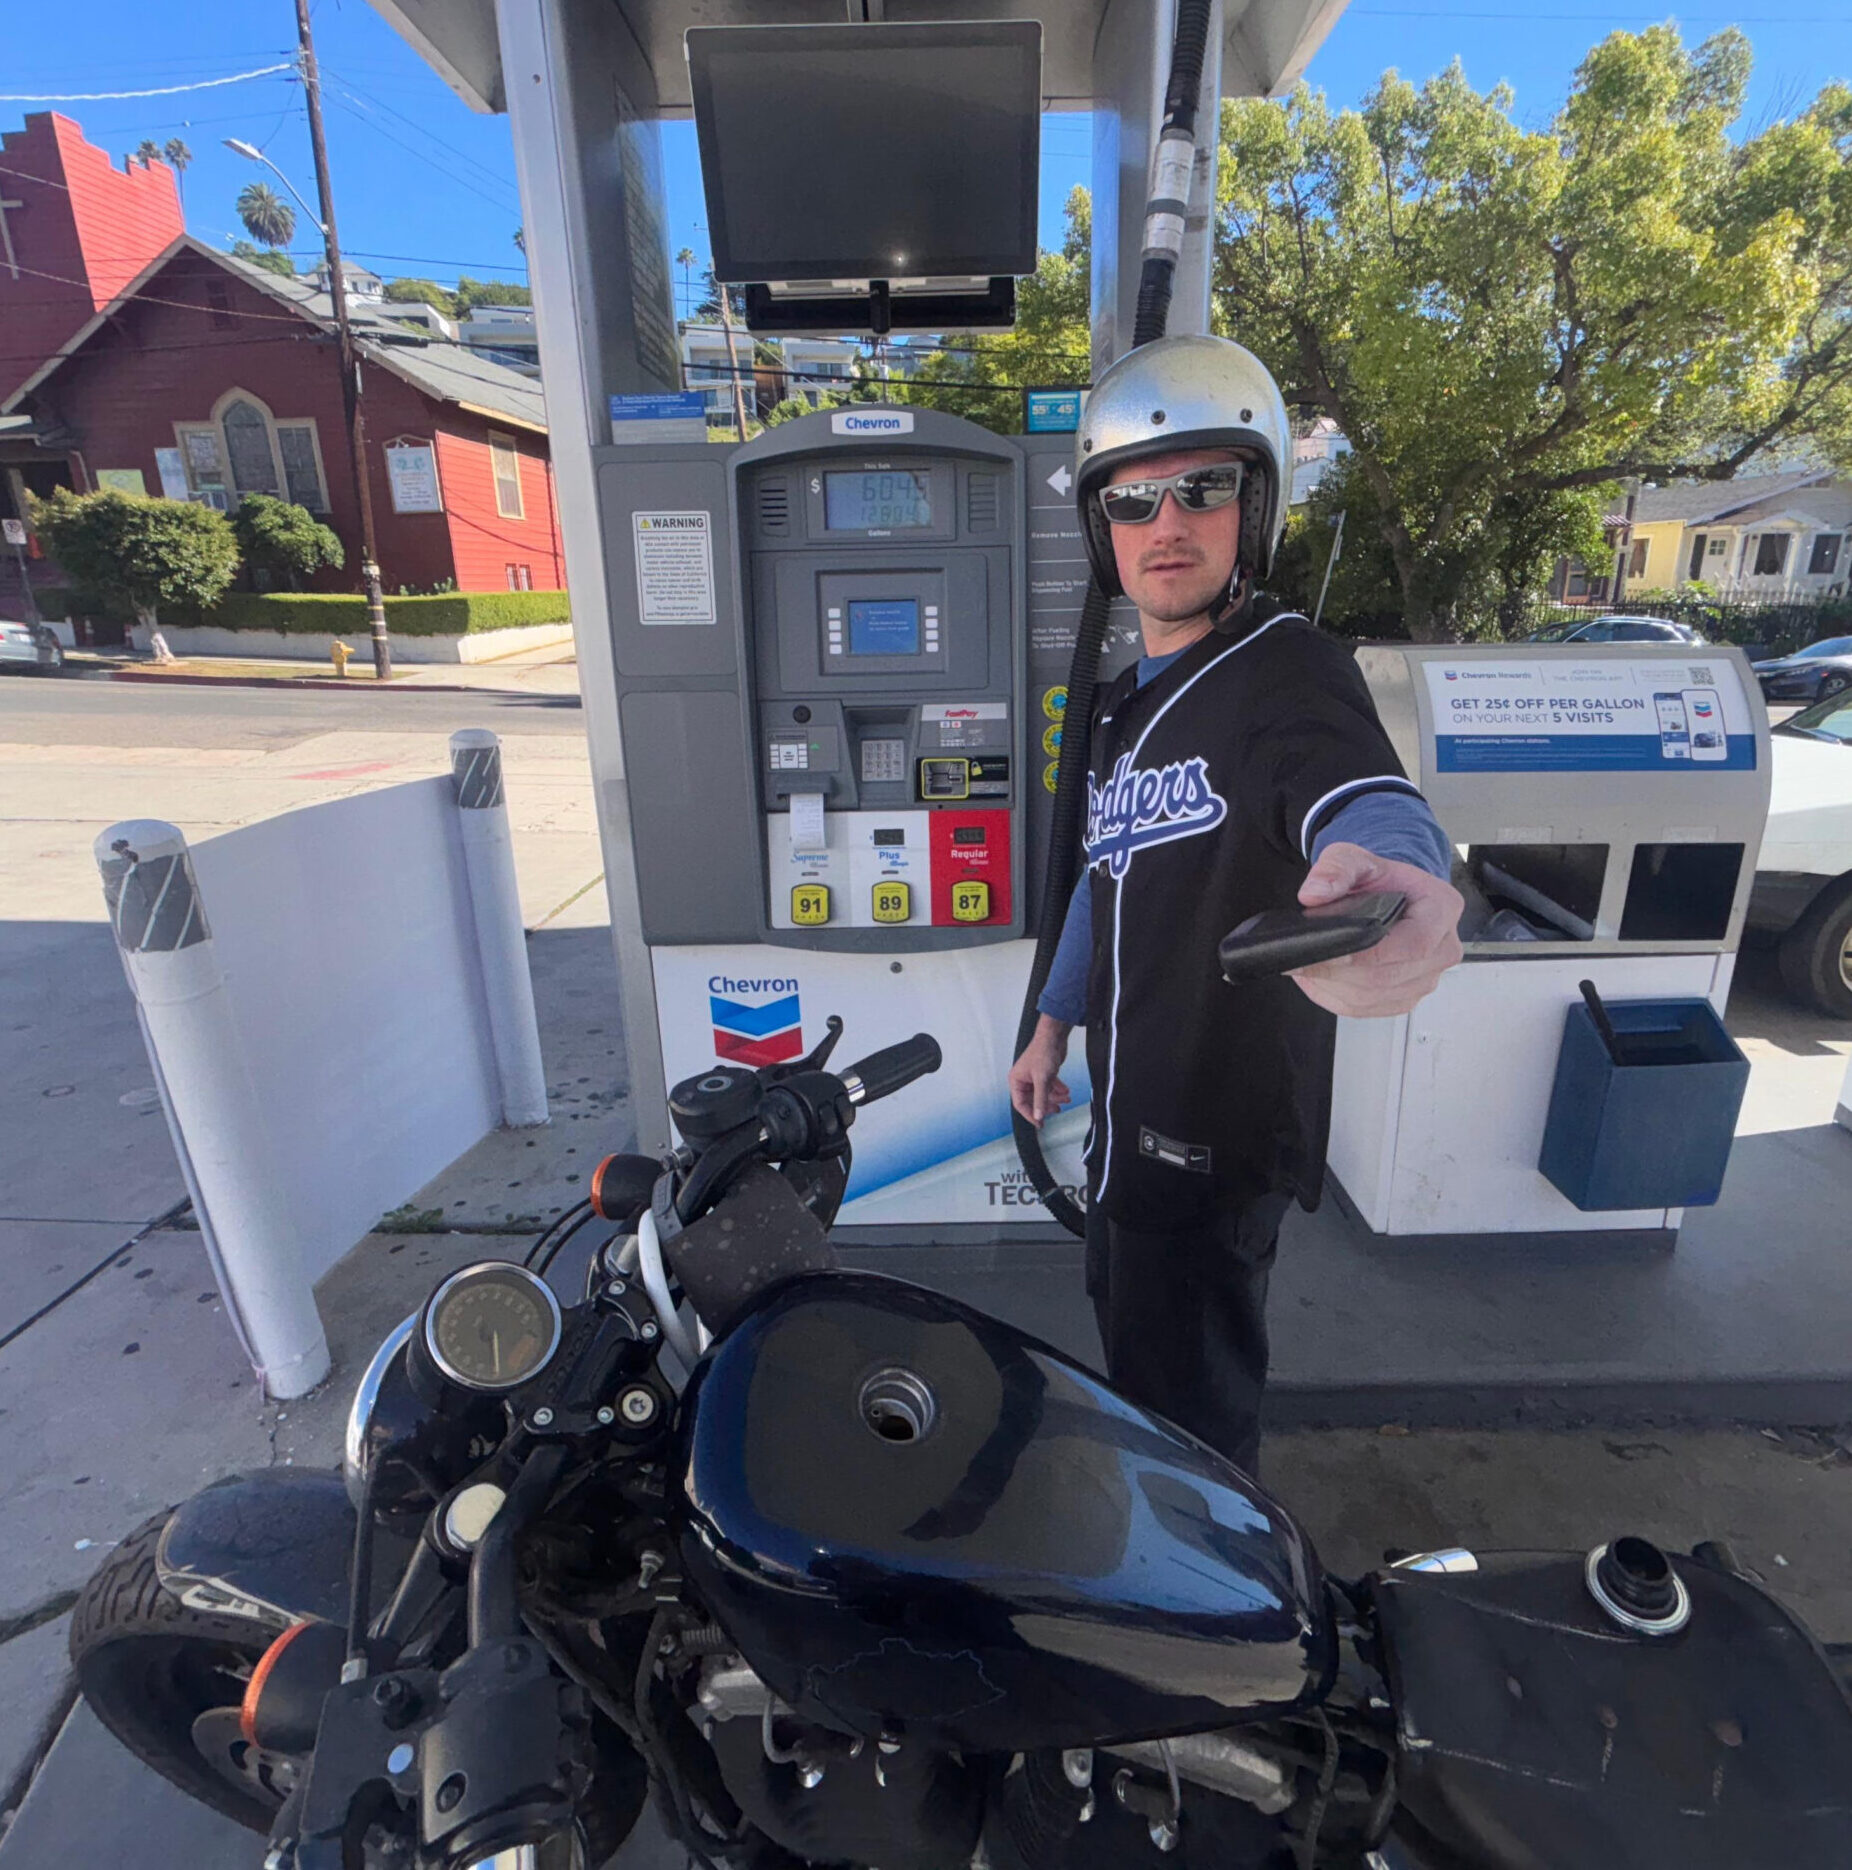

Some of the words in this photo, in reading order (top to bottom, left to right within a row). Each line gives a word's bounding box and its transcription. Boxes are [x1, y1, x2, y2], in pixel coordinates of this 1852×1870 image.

[845, 417, 900, 429] Chevron
[811, 478, 820, 494] $
[652, 518, 704, 528] WARNING
[1498, 671, 1532, 679] Rewards
[1451, 699, 1480, 709] GET
[1485, 699, 1510, 709] 25¢
[1515, 699, 1545, 709] OFF
[1550, 699, 1578, 709] PER
[1583, 698, 1645, 709] GALLON
[1453, 713, 1473, 724] ON
[1476, 713, 1512, 723] YOUR
[1515, 713, 1548, 723] NEXT
[1553, 712, 1562, 723] 5
[1566, 712, 1614, 723] VISITS
[879, 851, 900, 859] Plus
[951, 850, 988, 860] Regular
[800, 898, 820, 913] 91
[880, 896, 901, 910] 89
[959, 895, 981, 909] 87
[708, 976, 798, 993] Chevron
[1001, 1169, 1030, 1184] wit
